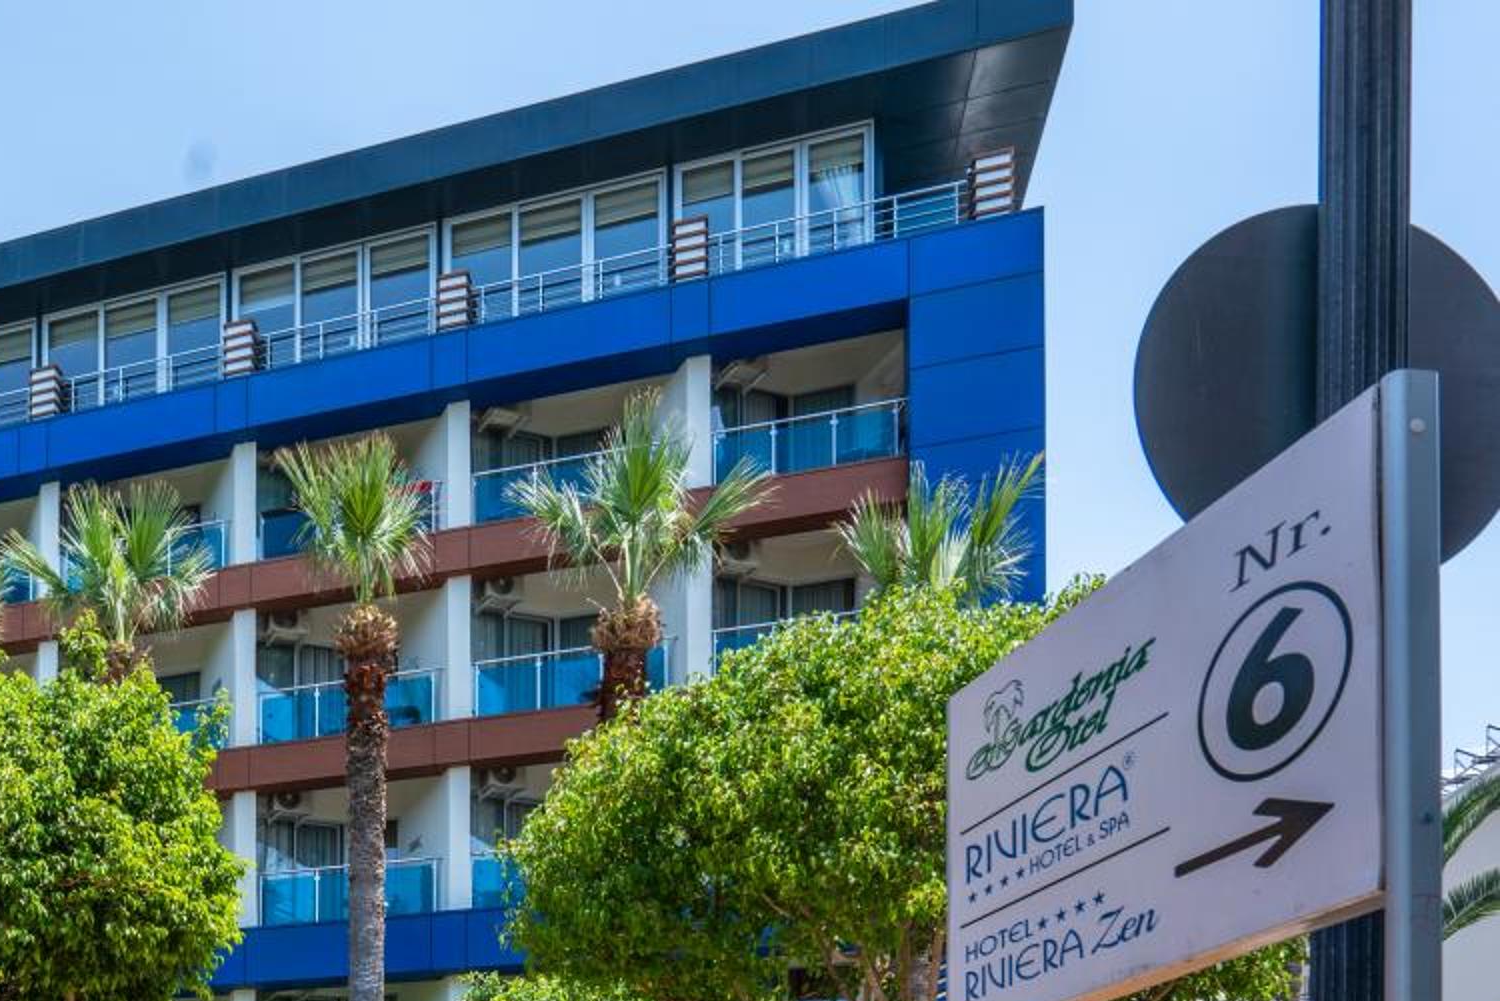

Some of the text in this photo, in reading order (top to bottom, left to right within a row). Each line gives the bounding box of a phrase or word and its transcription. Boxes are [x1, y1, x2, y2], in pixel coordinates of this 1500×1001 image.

[1229, 510, 1332, 593] Nr.
[966, 637, 1156, 780] Gardenia
[1225, 605, 1315, 751] 6
[1025, 688, 1117, 773] Otel
[965, 765, 1129, 885] RIVIERA
[1030, 811, 1130, 876] HOTEL & SPA
[965, 918, 1035, 964] HOTEL
[1091, 905, 1157, 956] Zen
